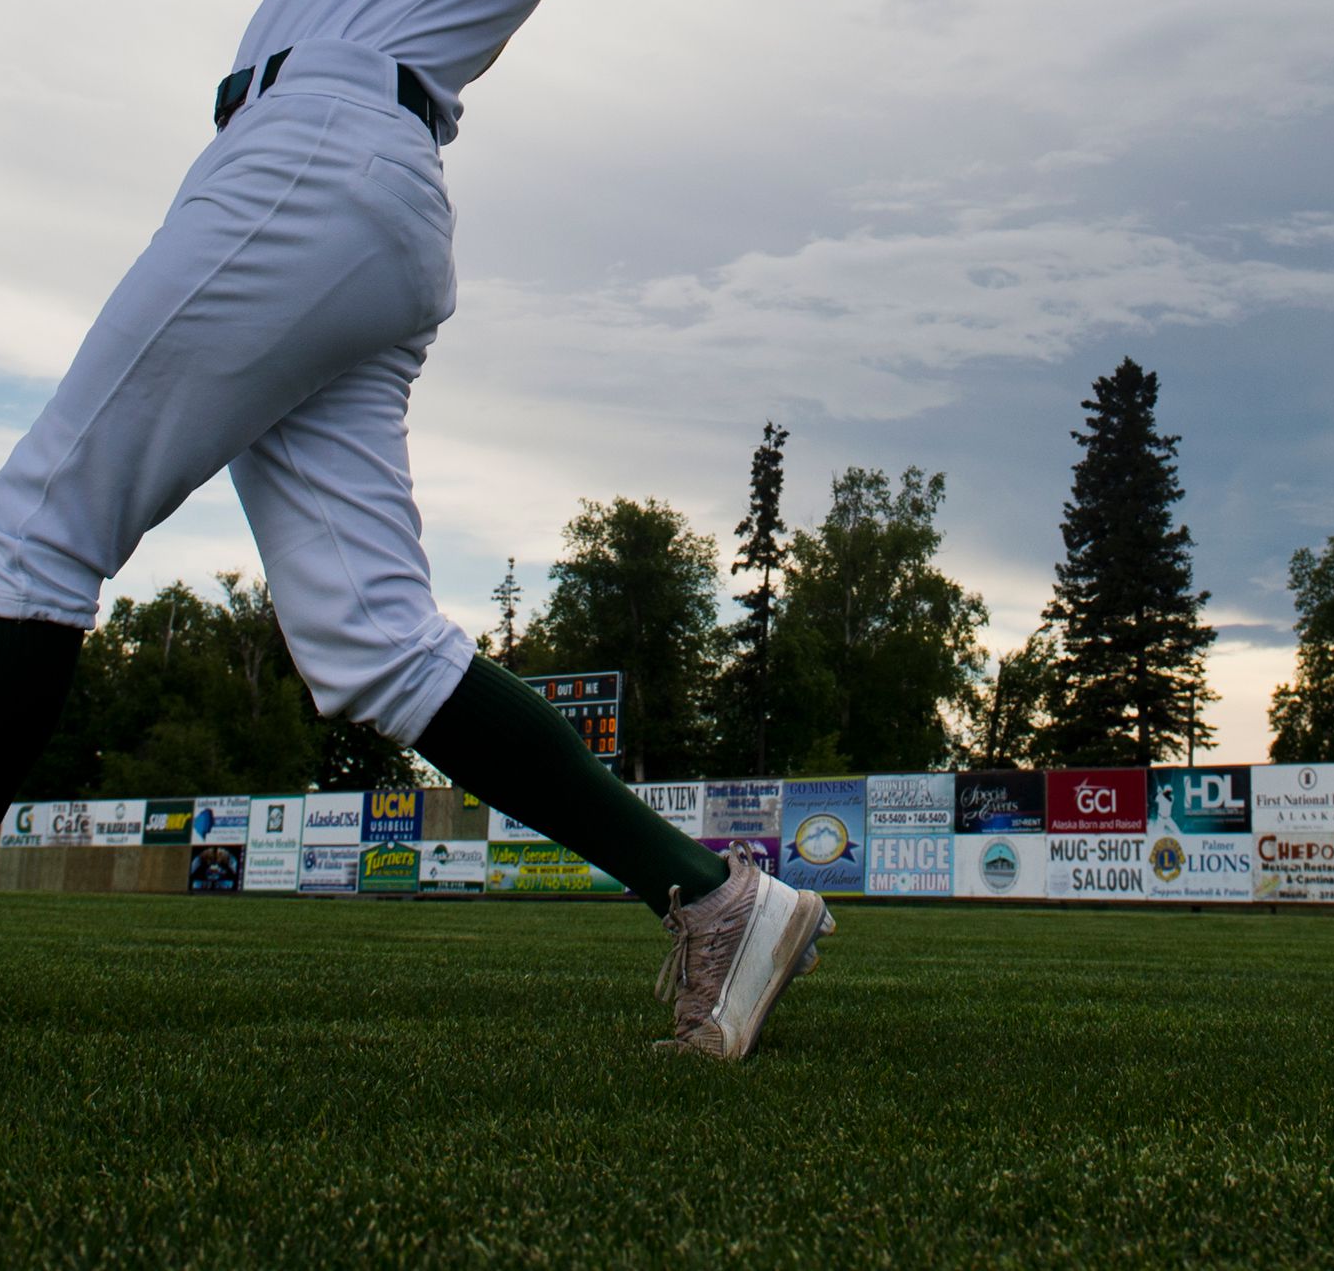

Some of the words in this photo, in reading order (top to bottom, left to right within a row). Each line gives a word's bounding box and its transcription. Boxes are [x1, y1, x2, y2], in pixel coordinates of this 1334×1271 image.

[557, 684, 573, 696] OUT
[790, 783, 806, 794] GO
[809, 781, 857, 794] MINERS!
[960, 784, 1008, 807] Special
[1183, 774, 1245, 809] HDL
[371, 793, 415, 818] UCM
[667, 786, 699, 810] VIEW
[869, 788, 934, 808] PIZZA
[1077, 789, 1117, 813] GCI
[1257, 795, 1281, 807] First
[1283, 793, 1329, 806] National
[978, 798, 1018, 821] Events
[146, 813, 191, 831] SUBWAY
[370, 821, 414, 832] USIBELLI
[1052, 819, 1076, 829] Alaska
[1078, 819, 1096, 829] Born
[1097, 819, 1114, 829] and
[1116, 819, 1142, 829] Raised
[2, 834, 42, 846] GRANITE
[1202, 840, 1234, 851] Palmer
[491, 846, 521, 866] Valley
[523, 845, 559, 863] General
[870, 837, 950, 870] FENCE
[1050, 839, 1144, 861] MUG-SHOT
[1187, 854, 1250, 873] LIONS
[1262, 863, 1301, 872] Mexican
[869, 873, 950, 891] EMPORIUM
[1072, 868, 1144, 893] SALOON
[1296, 874, 1334, 884] Cantina
